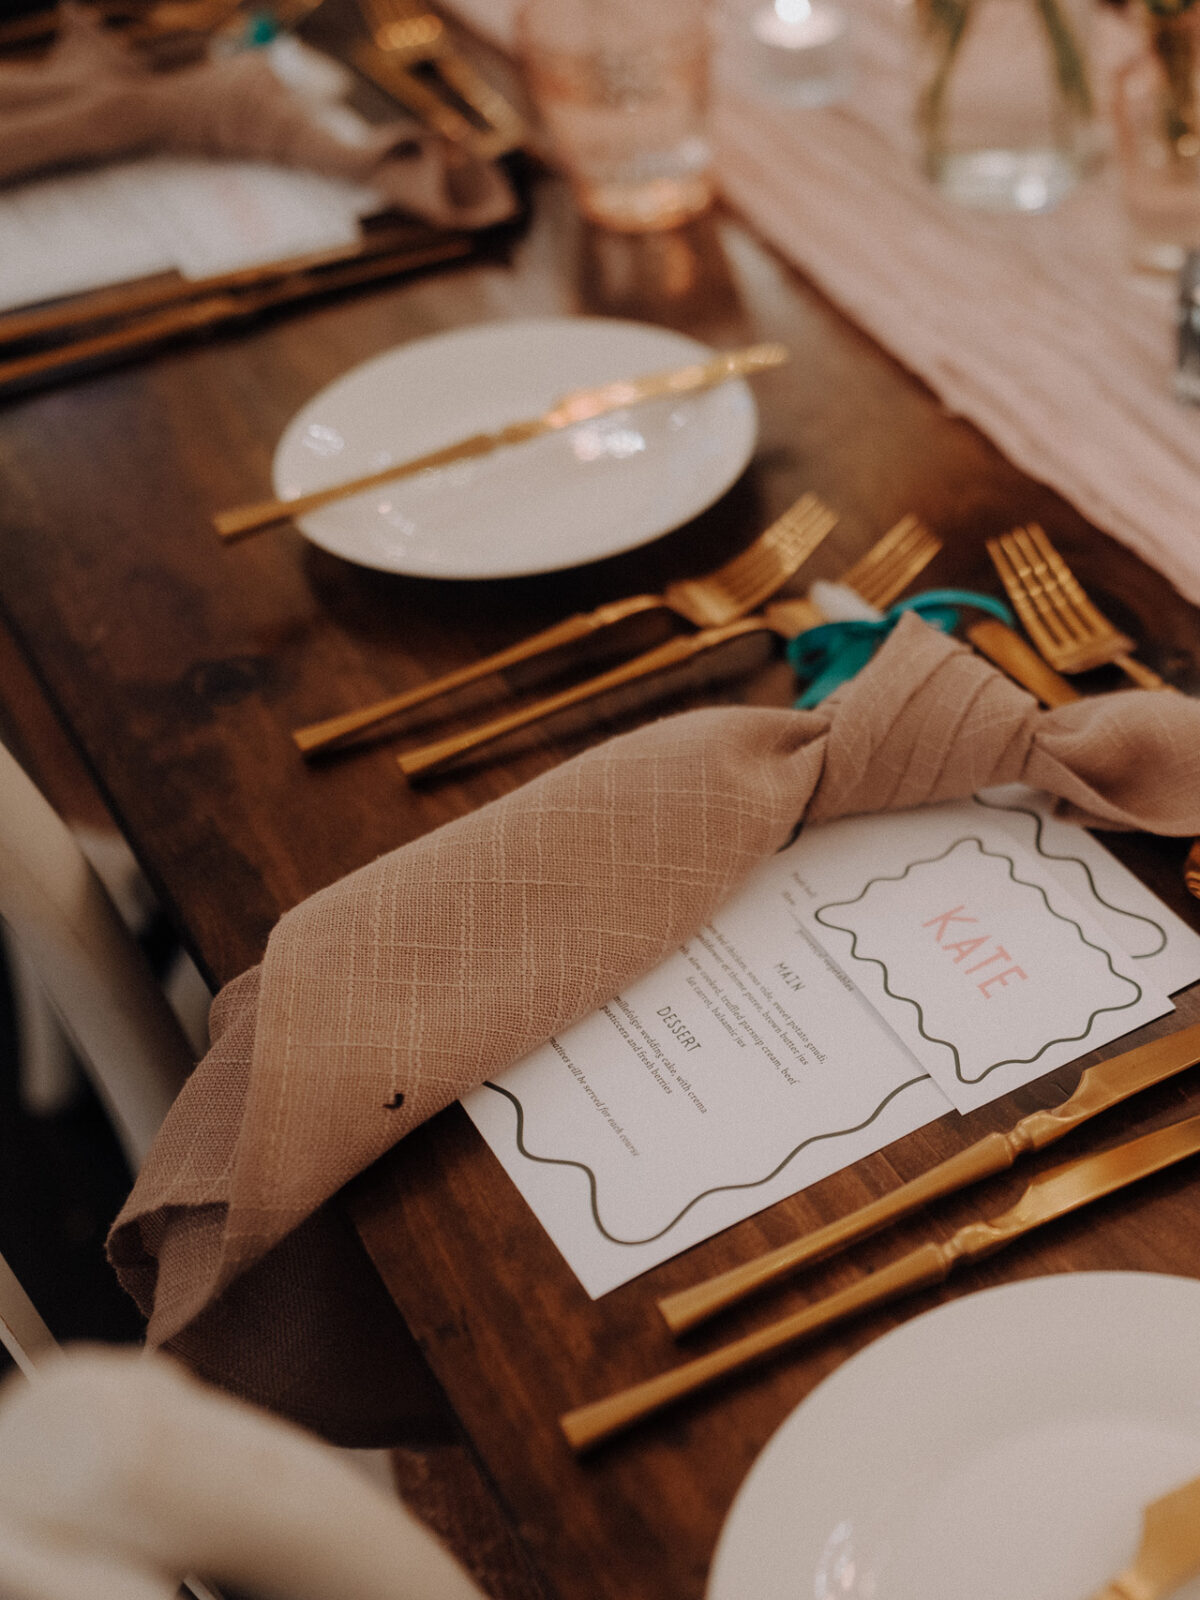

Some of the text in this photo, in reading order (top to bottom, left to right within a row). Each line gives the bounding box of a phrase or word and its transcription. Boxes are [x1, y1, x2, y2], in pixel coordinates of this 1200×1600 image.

[773, 962, 806, 991] MAIN
[922, 905, 1029, 999] KATE
[656, 1006, 702, 1052] DESSERT
[711, 1007, 738, 1037] balsamic
[733, 1035, 746, 1048] jus
[720, 995, 746, 1020] truffled
[738, 1020, 765, 1046] parsnip
[761, 1046, 781, 1070] cream,
[780, 1067, 800, 1085] beef
[762, 1009, 783, 1034] brown
[779, 1031, 800, 1054] butter
[795, 1053, 809, 1066] jus
[772, 1001, 791, 1021] sweet
[786, 1020, 810, 1043] potato
[803, 1042, 829, 1065] gnudi,
[567, 1063, 583, 1077] will
[577, 1075, 587, 1085] be
[583, 1085, 606, 1108] served
[595, 1106, 611, 1118] for
[627, 1039, 643, 1052] and
[637, 1051, 656, 1070] fresh
[651, 1068, 673, 1094] berries
[640, 1030, 664, 1059] wedding
[661, 1058, 677, 1077] cake,
[676, 1075, 692, 1092] with
[687, 1091, 708, 1114] crema
